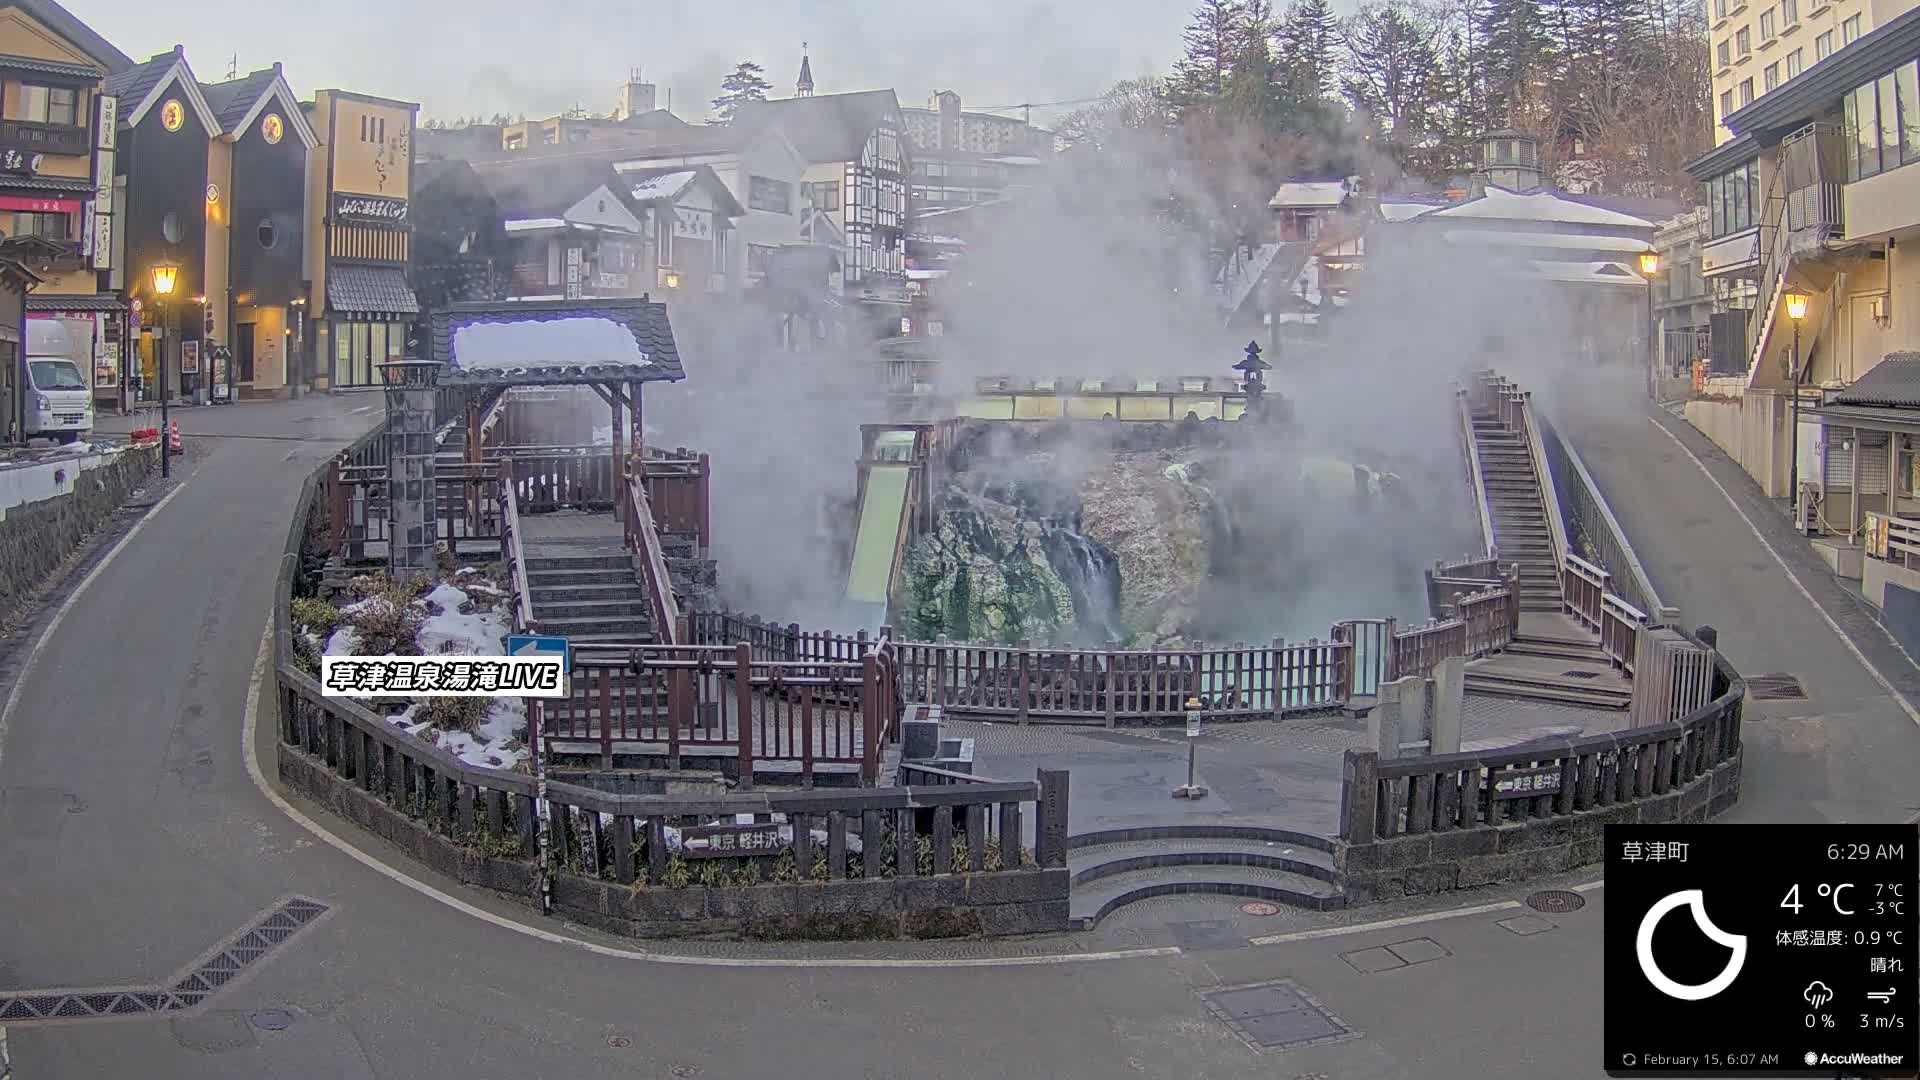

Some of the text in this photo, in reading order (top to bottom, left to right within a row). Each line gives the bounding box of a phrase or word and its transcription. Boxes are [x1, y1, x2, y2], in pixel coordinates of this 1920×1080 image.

[1512, 776, 1532, 792] 東京
[709, 831, 779, 851] 東京 軽井沢
